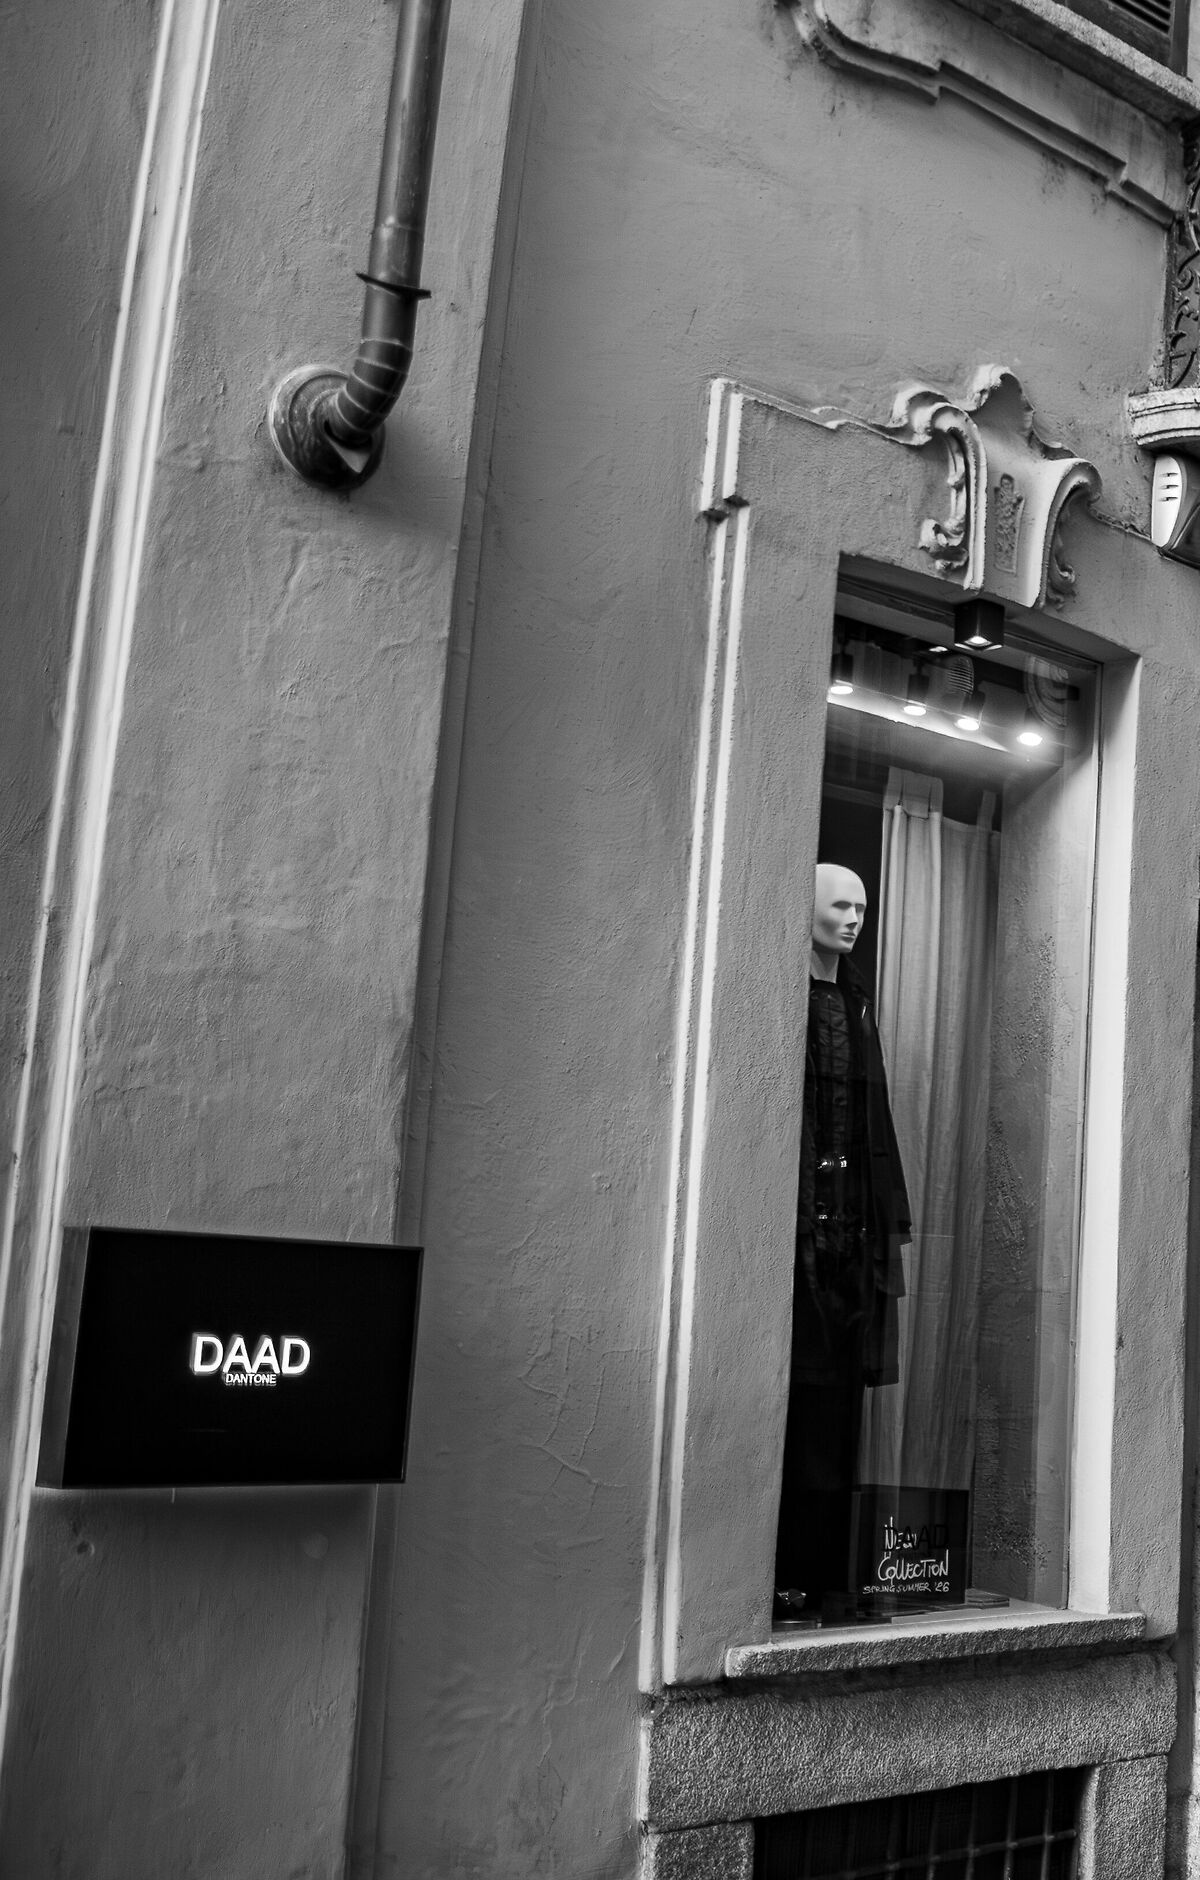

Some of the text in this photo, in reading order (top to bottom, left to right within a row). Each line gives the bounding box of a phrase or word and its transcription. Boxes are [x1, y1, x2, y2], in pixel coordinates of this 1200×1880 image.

[191, 1334, 311, 1374] DAAD
[225, 1373, 276, 1385] DANTONE
[863, 1584, 895, 1594] SPRING
[896, 1582, 931, 1593] SUMMER
